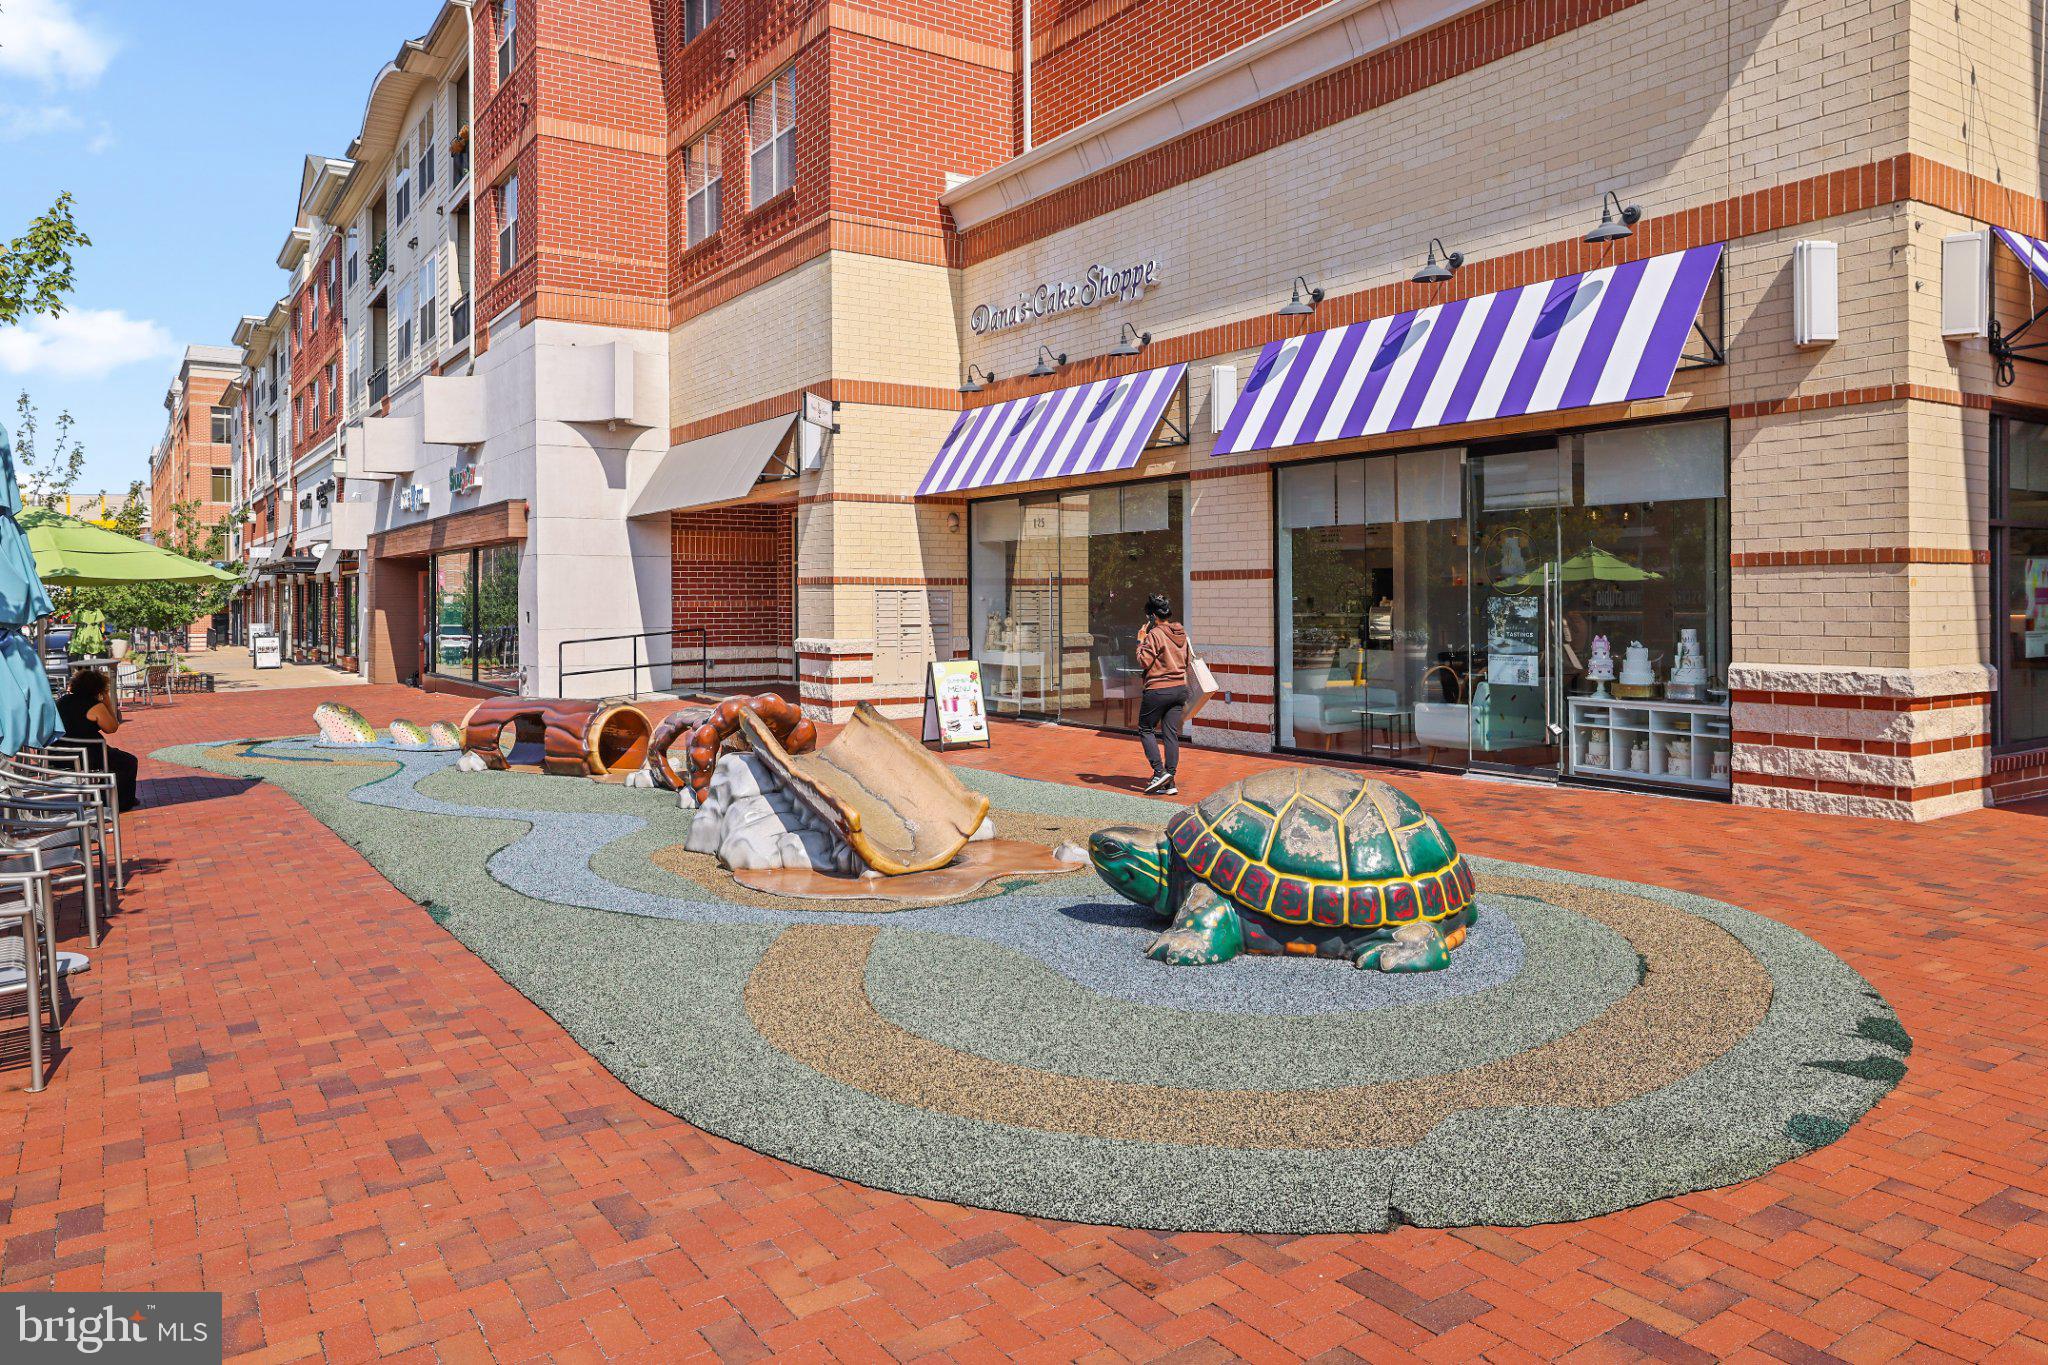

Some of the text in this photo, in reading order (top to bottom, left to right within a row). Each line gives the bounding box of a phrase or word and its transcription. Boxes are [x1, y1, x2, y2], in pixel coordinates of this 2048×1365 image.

[970, 260, 1155, 335] Dana's Cake Shoppe
